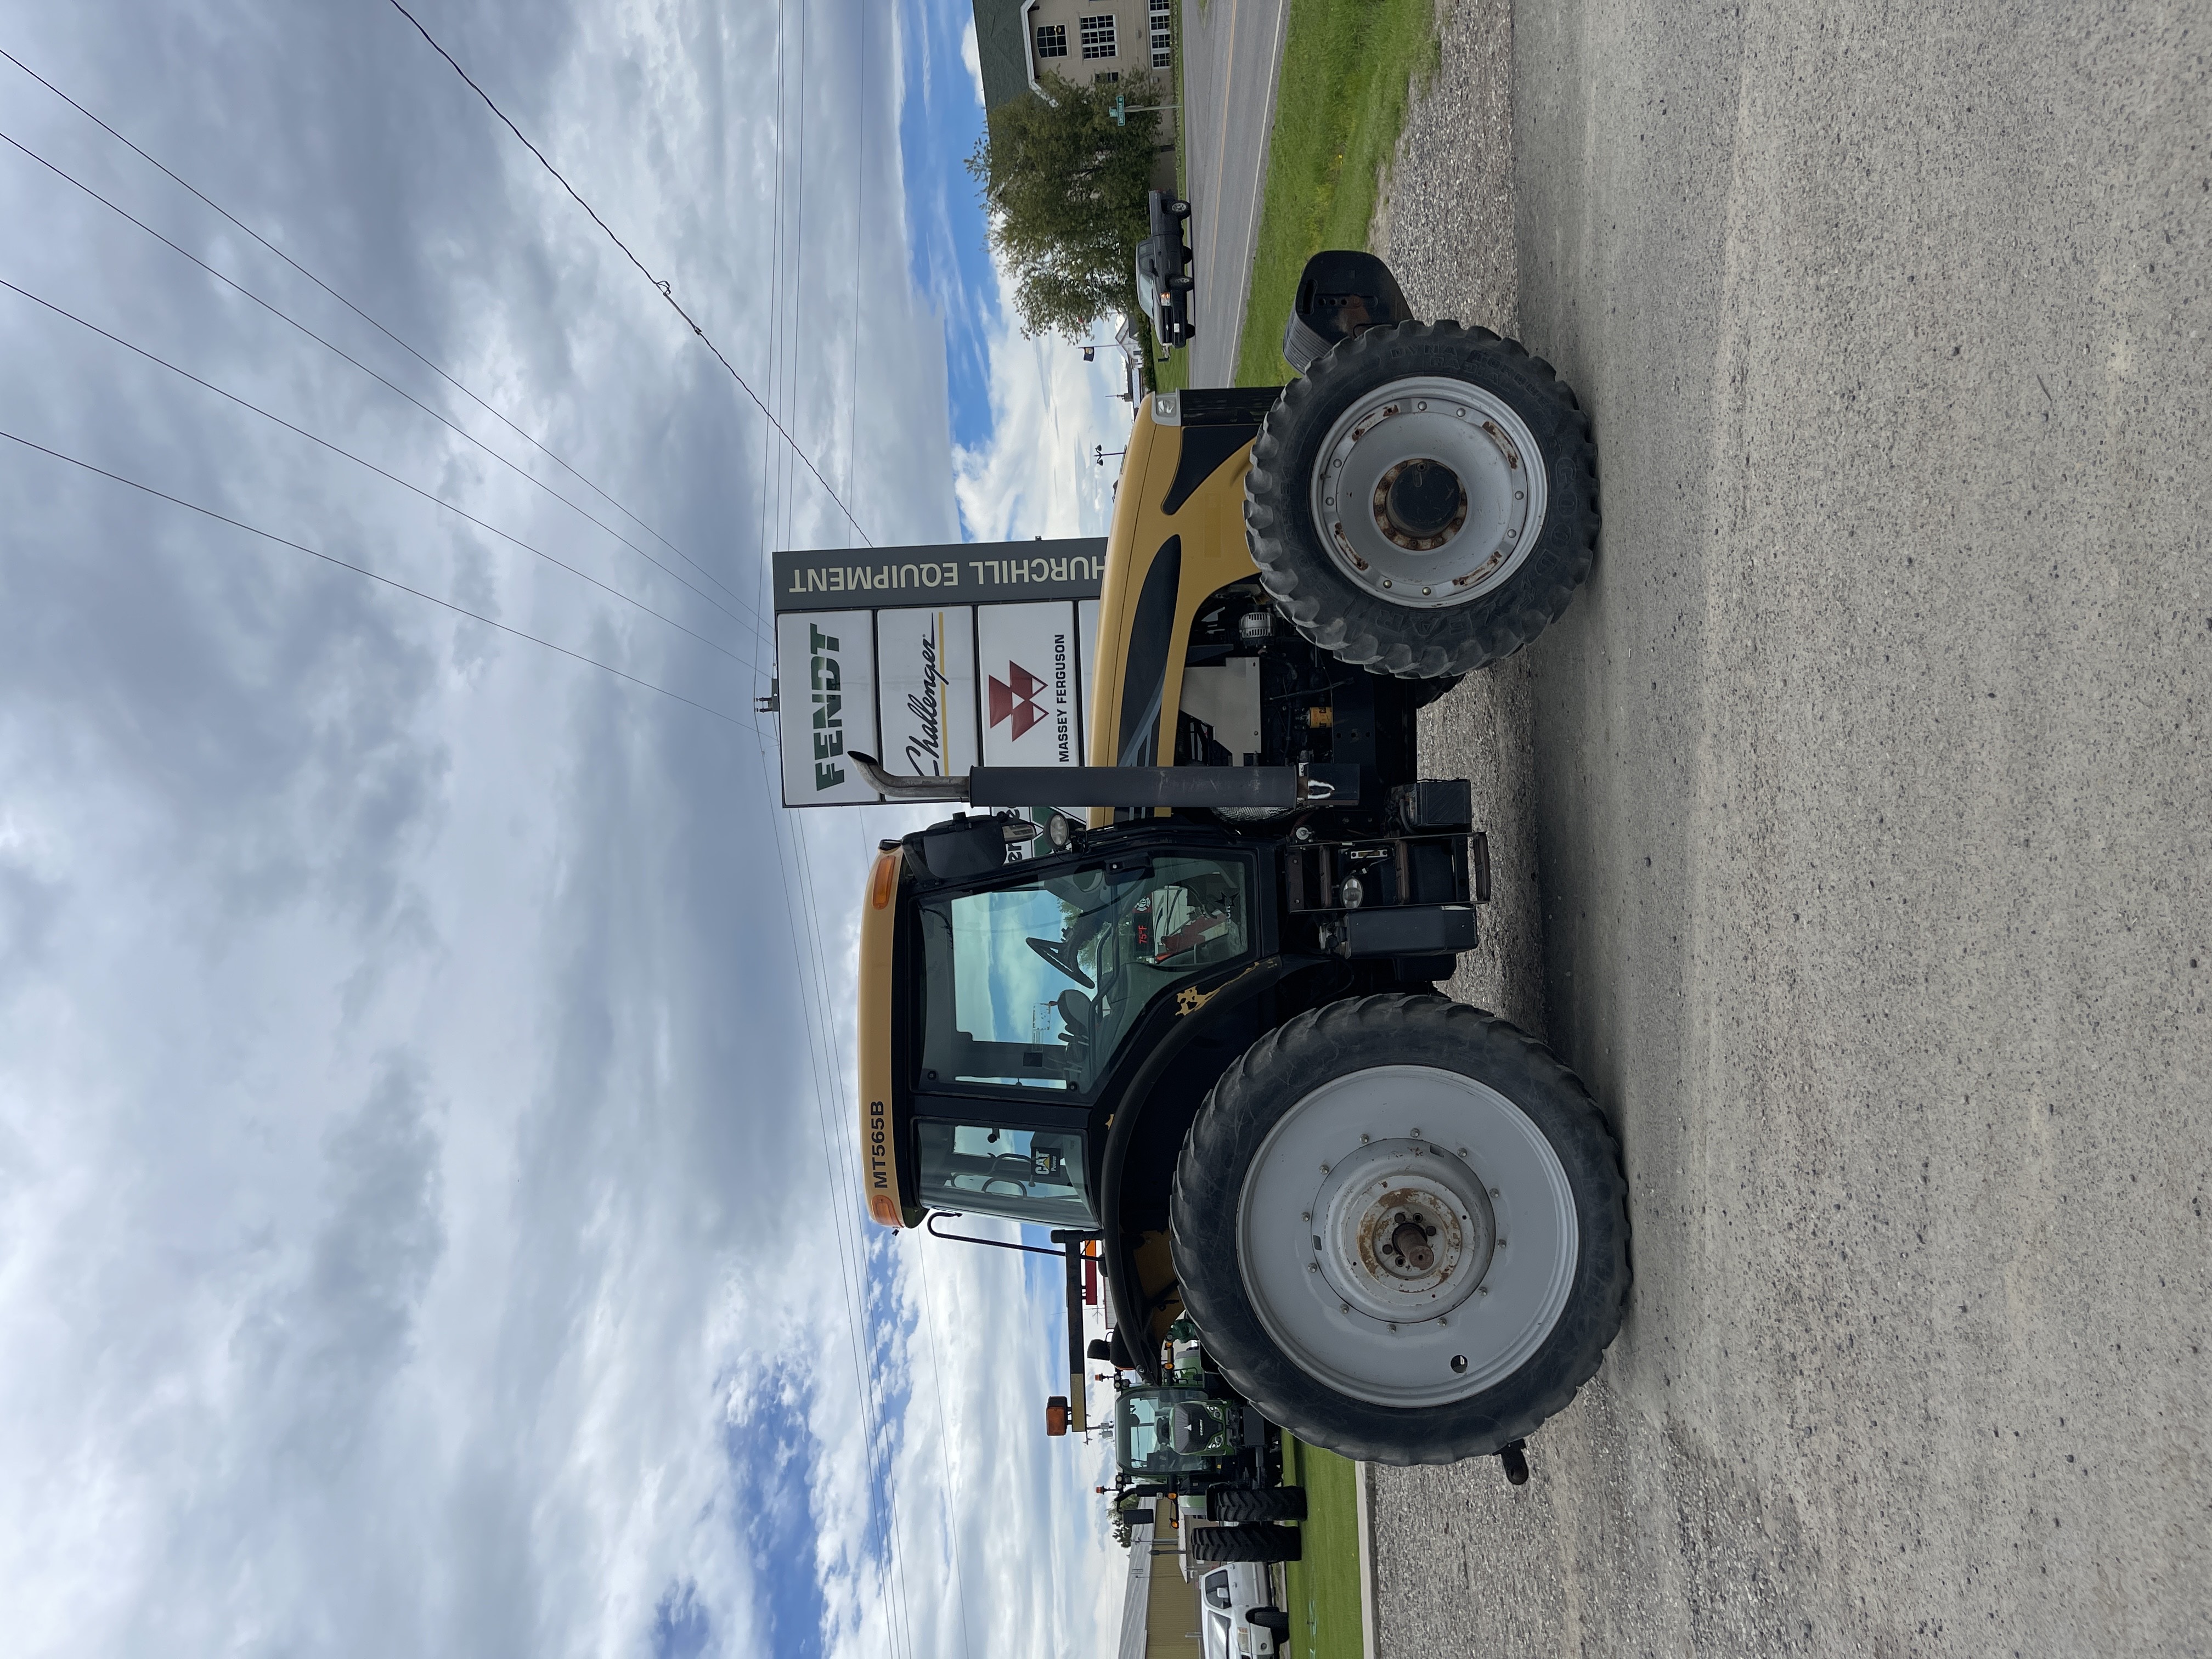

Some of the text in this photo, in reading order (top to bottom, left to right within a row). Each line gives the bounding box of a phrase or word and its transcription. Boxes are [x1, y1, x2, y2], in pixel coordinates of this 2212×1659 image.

[789, 556, 1105, 592] HURCHILL EQUIPMENT
[810, 623, 845, 791] FENDT
[906, 612, 949, 776] Challenger
[1054, 634, 1069, 763] MASSEY FERGUSON
[870, 1101, 888, 1188] MT565B
[1035, 1150, 1050, 1175] CAT
